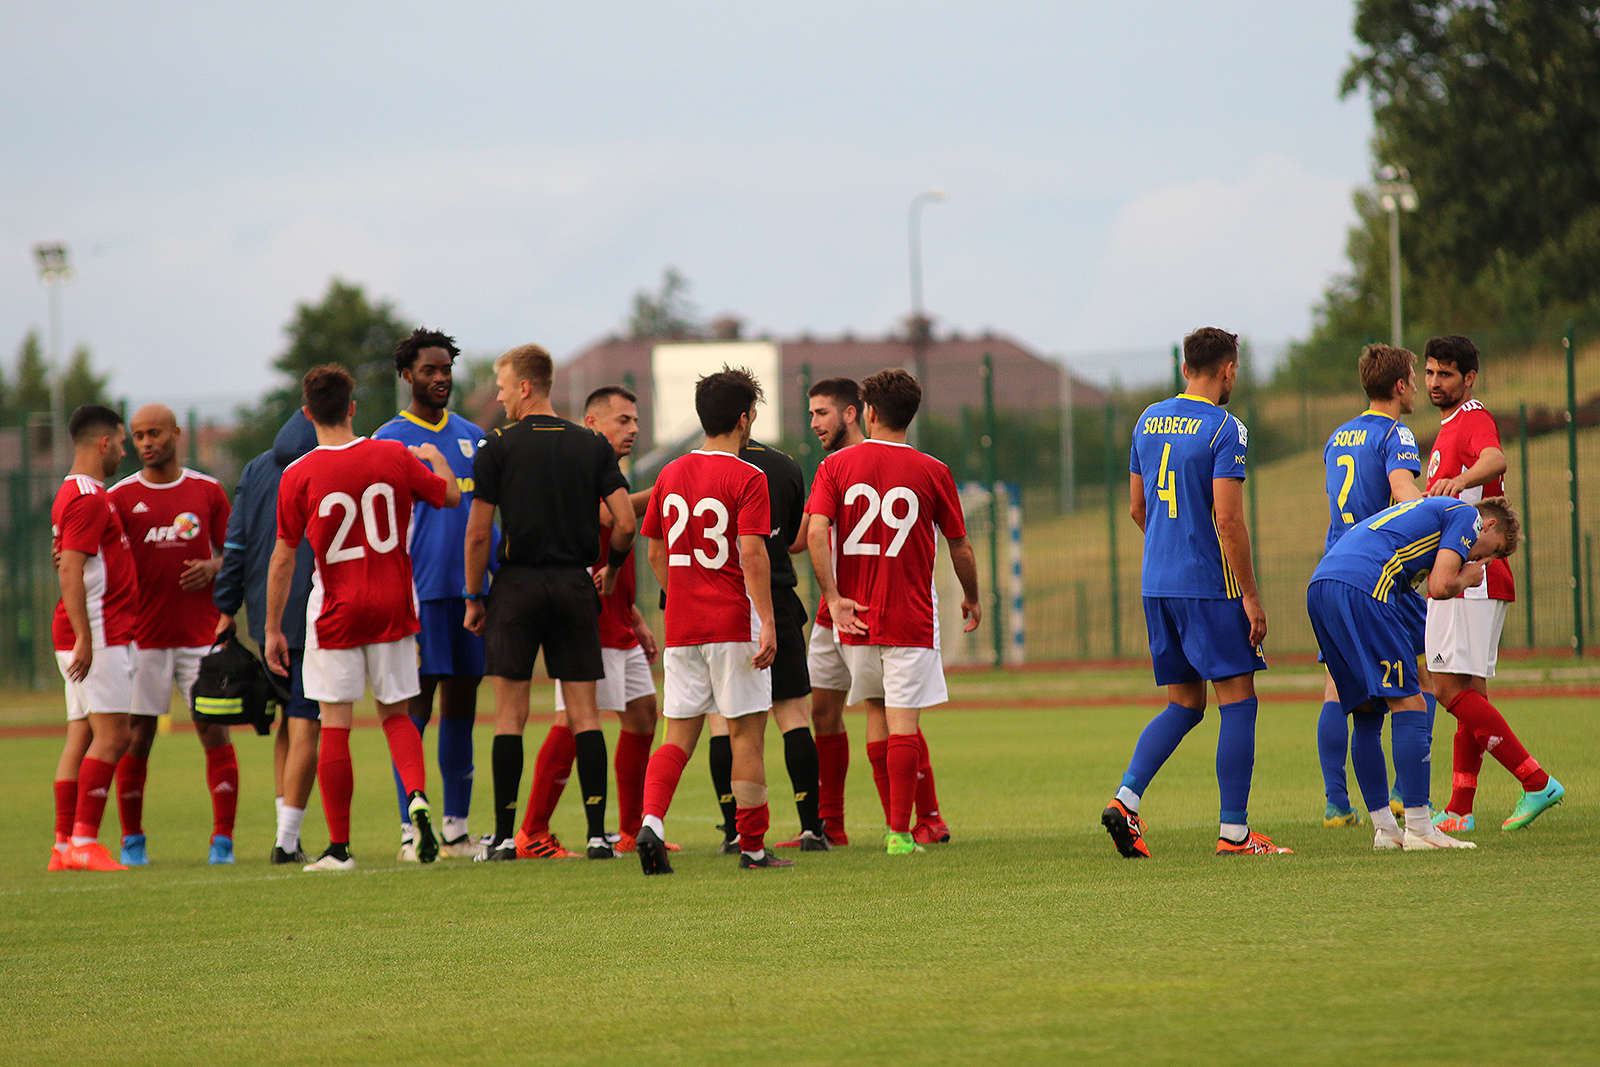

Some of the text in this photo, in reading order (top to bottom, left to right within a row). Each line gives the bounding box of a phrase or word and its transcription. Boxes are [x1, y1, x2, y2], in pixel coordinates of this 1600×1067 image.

[1142, 416, 1202, 435] SOŁDECKI
[1333, 429, 1367, 447] SOCHA
[1157, 442, 1178, 519] 4
[1336, 454, 1355, 524] 2
[318, 482, 399, 565] 20
[662, 493, 729, 570] 23
[842, 483, 919, 558] 29
[1380, 659, 1404, 688] 21
